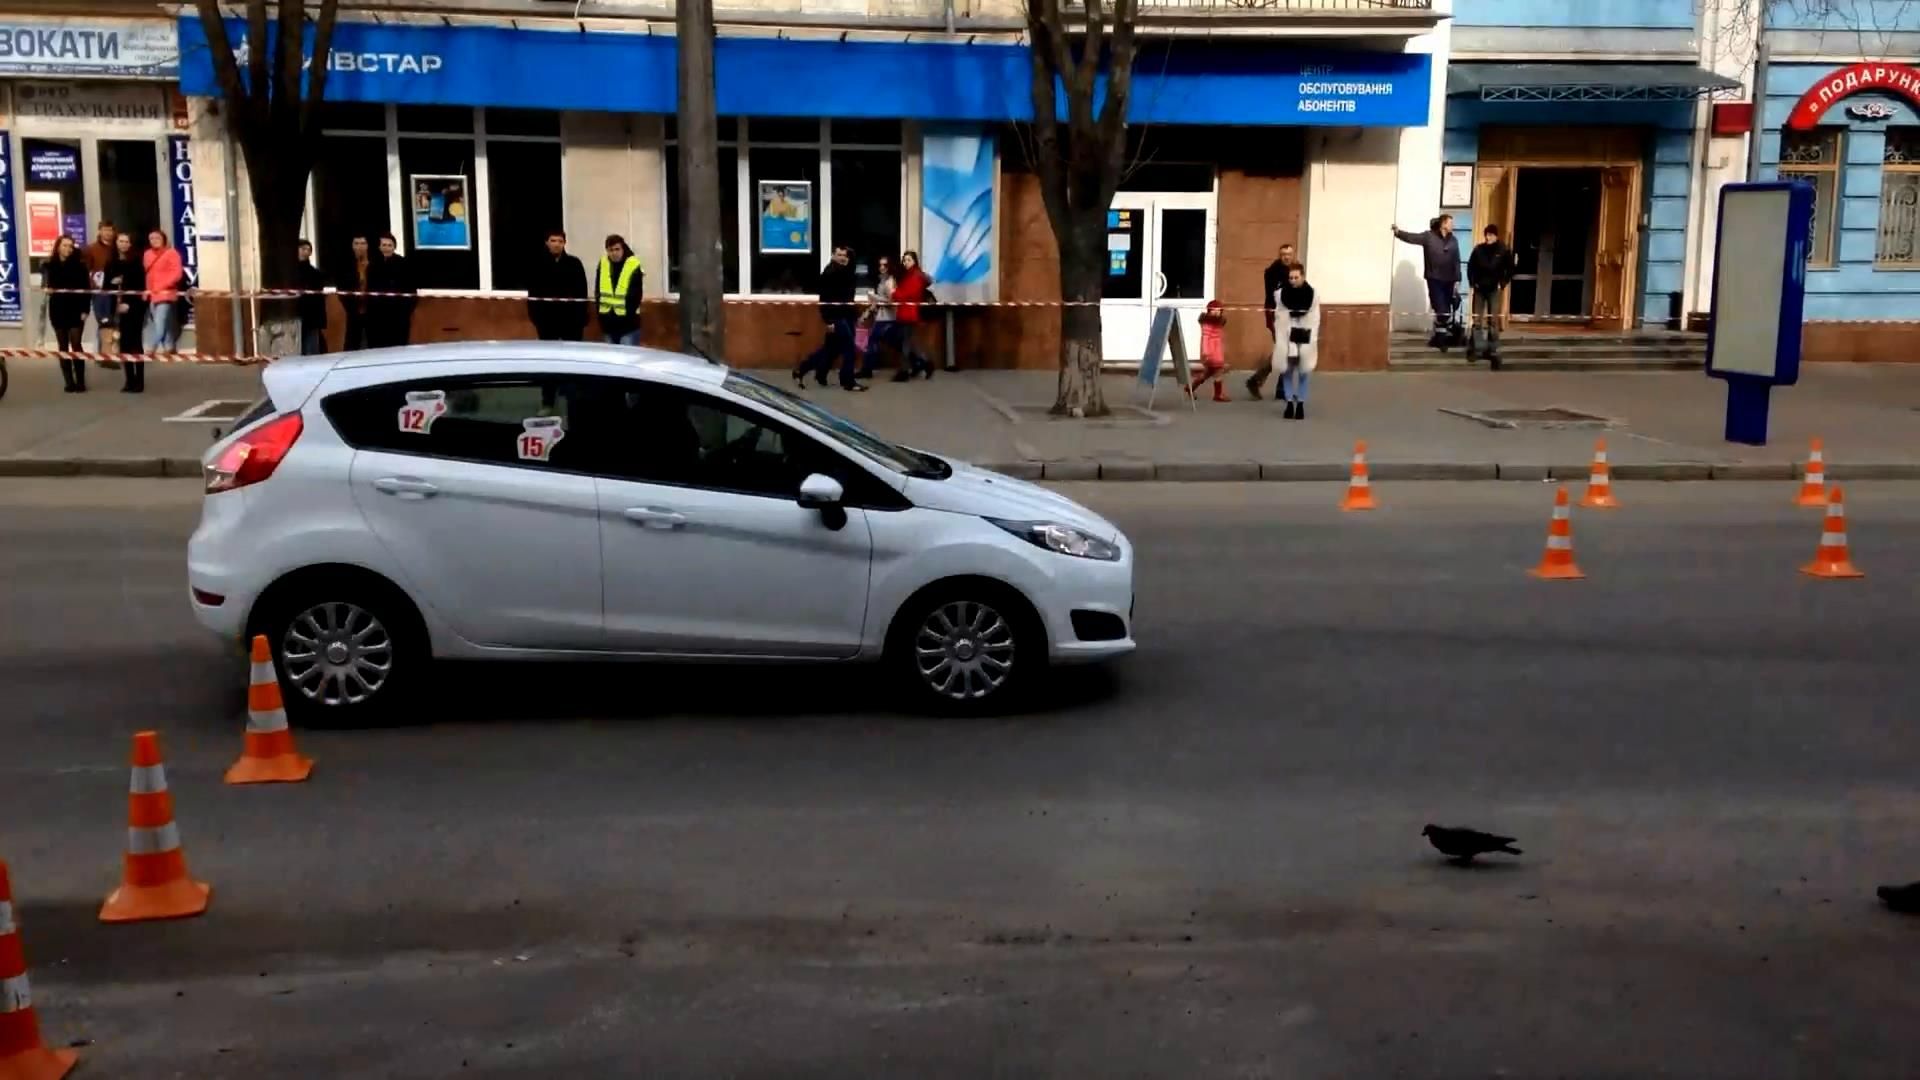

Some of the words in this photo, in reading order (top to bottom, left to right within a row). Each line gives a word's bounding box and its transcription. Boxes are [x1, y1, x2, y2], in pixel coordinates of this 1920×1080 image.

[301, 47, 442, 74] ЇВСТАР
[1299, 82, 1393, 95] ОБСЛУГОВУВАННЯ
[16, 102, 159, 119] СТРАХУВАННЯ
[1297, 99, 1357, 112] АБОНЕНТІВ
[402, 409, 424, 430] 12
[520, 436, 545, 458] 15
